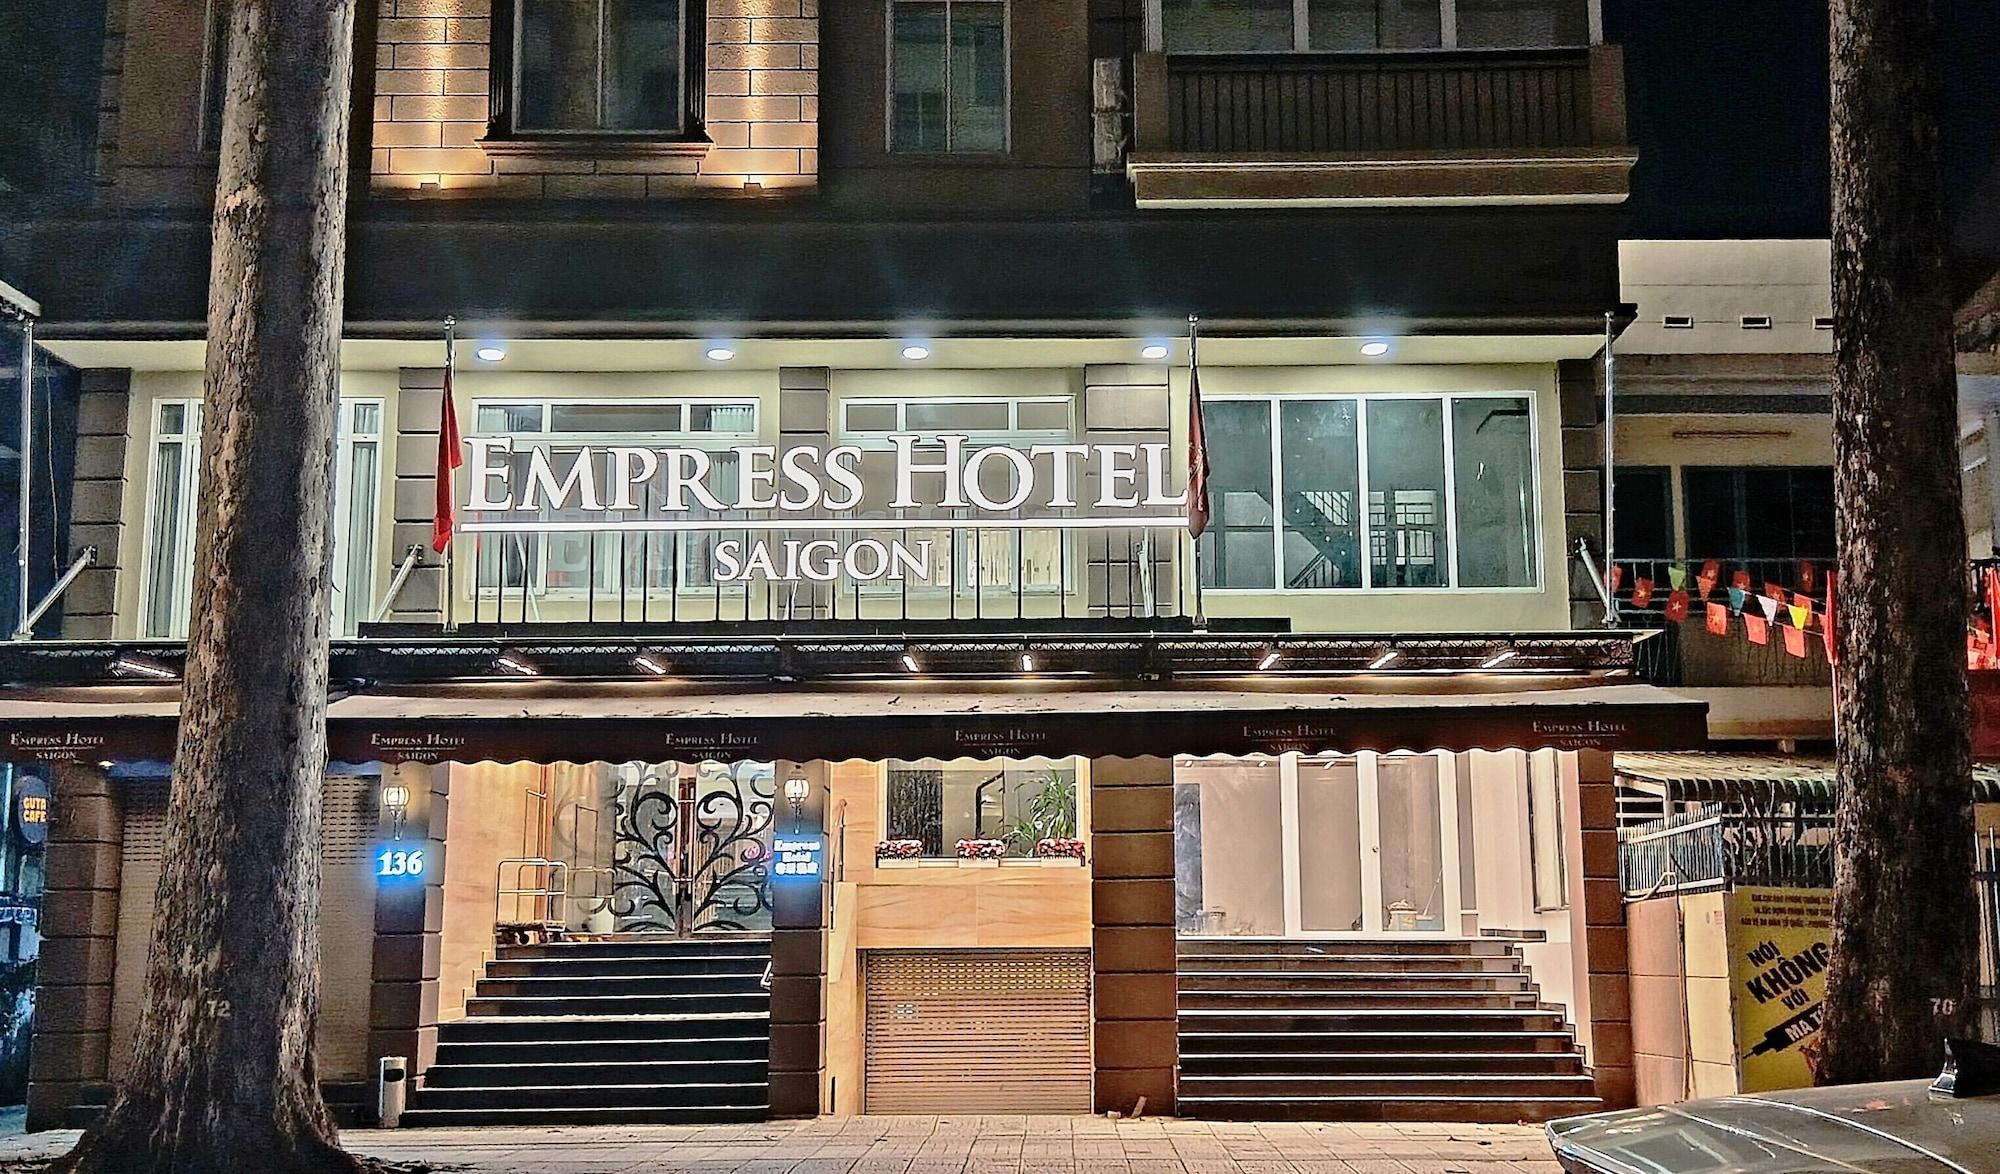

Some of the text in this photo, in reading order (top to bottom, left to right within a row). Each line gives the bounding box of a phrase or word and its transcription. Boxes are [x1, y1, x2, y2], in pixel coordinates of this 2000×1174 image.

[462, 435, 1189, 513] EMPRESS HOTEL
[713, 539, 932, 583] SAIGON
[376, 849, 425, 876] 136
[1784, 1019, 1814, 1042] MA
